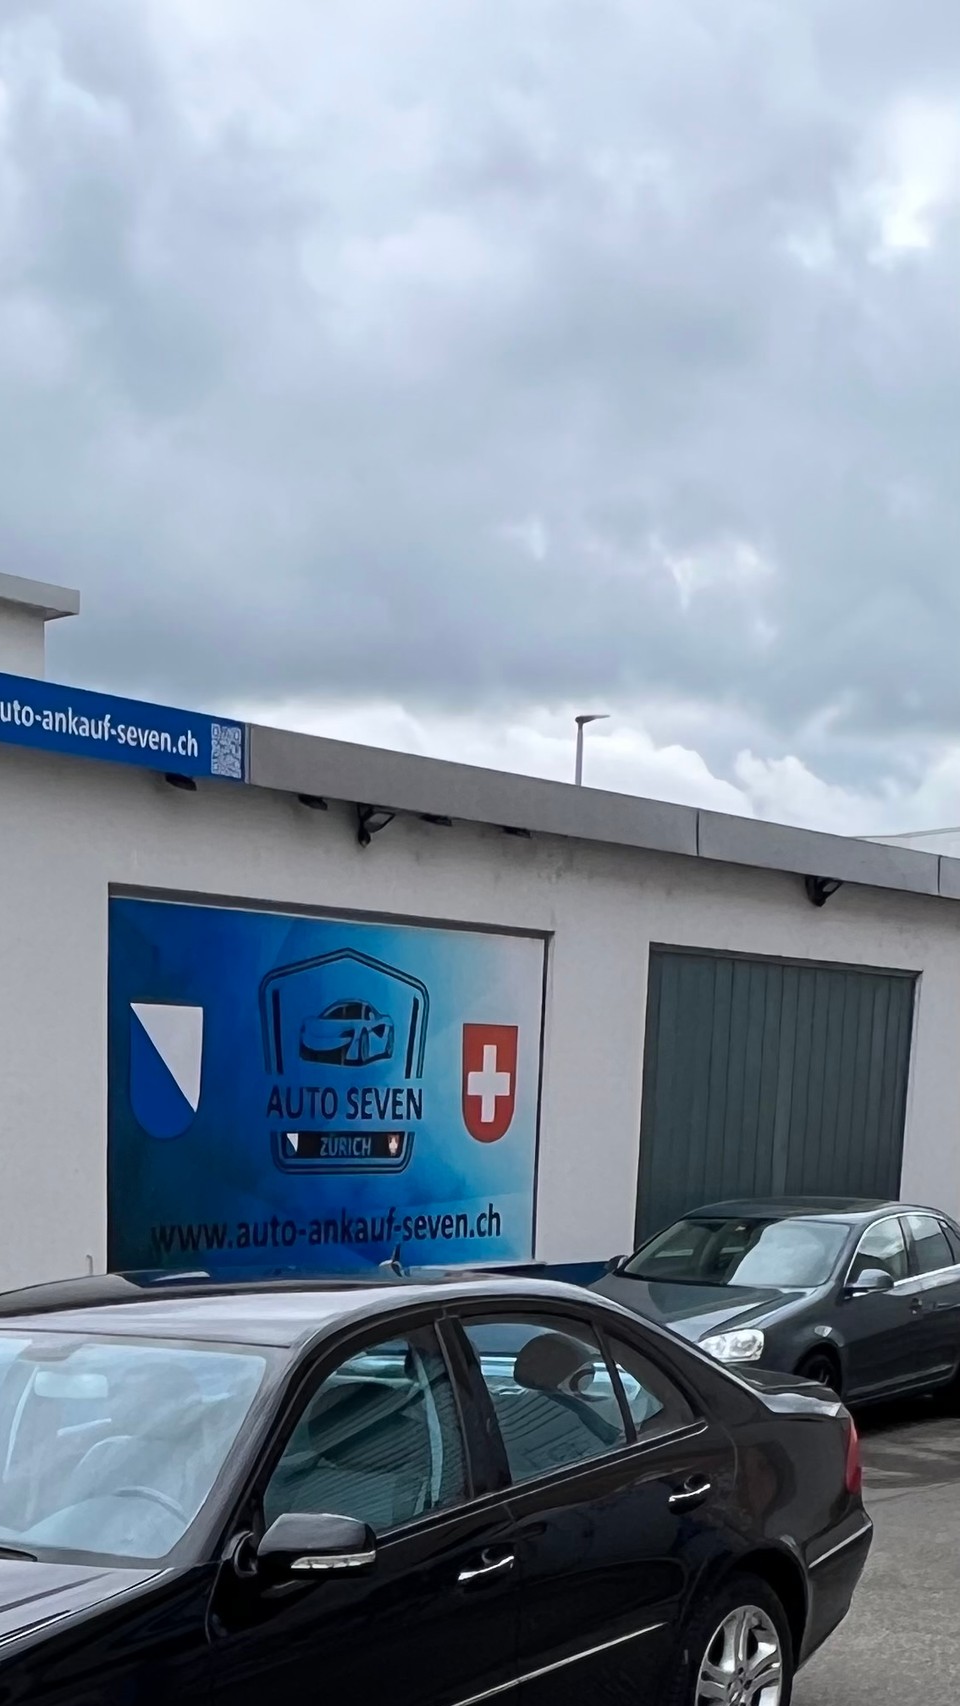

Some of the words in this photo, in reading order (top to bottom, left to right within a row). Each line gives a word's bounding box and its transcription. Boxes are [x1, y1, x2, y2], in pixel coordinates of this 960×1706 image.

[266, 1084, 338, 1120] AUTO
[345, 1086, 423, 1120] SEVEN
[151, 1203, 501, 1251] www.auto-ankauf-seven.ch
